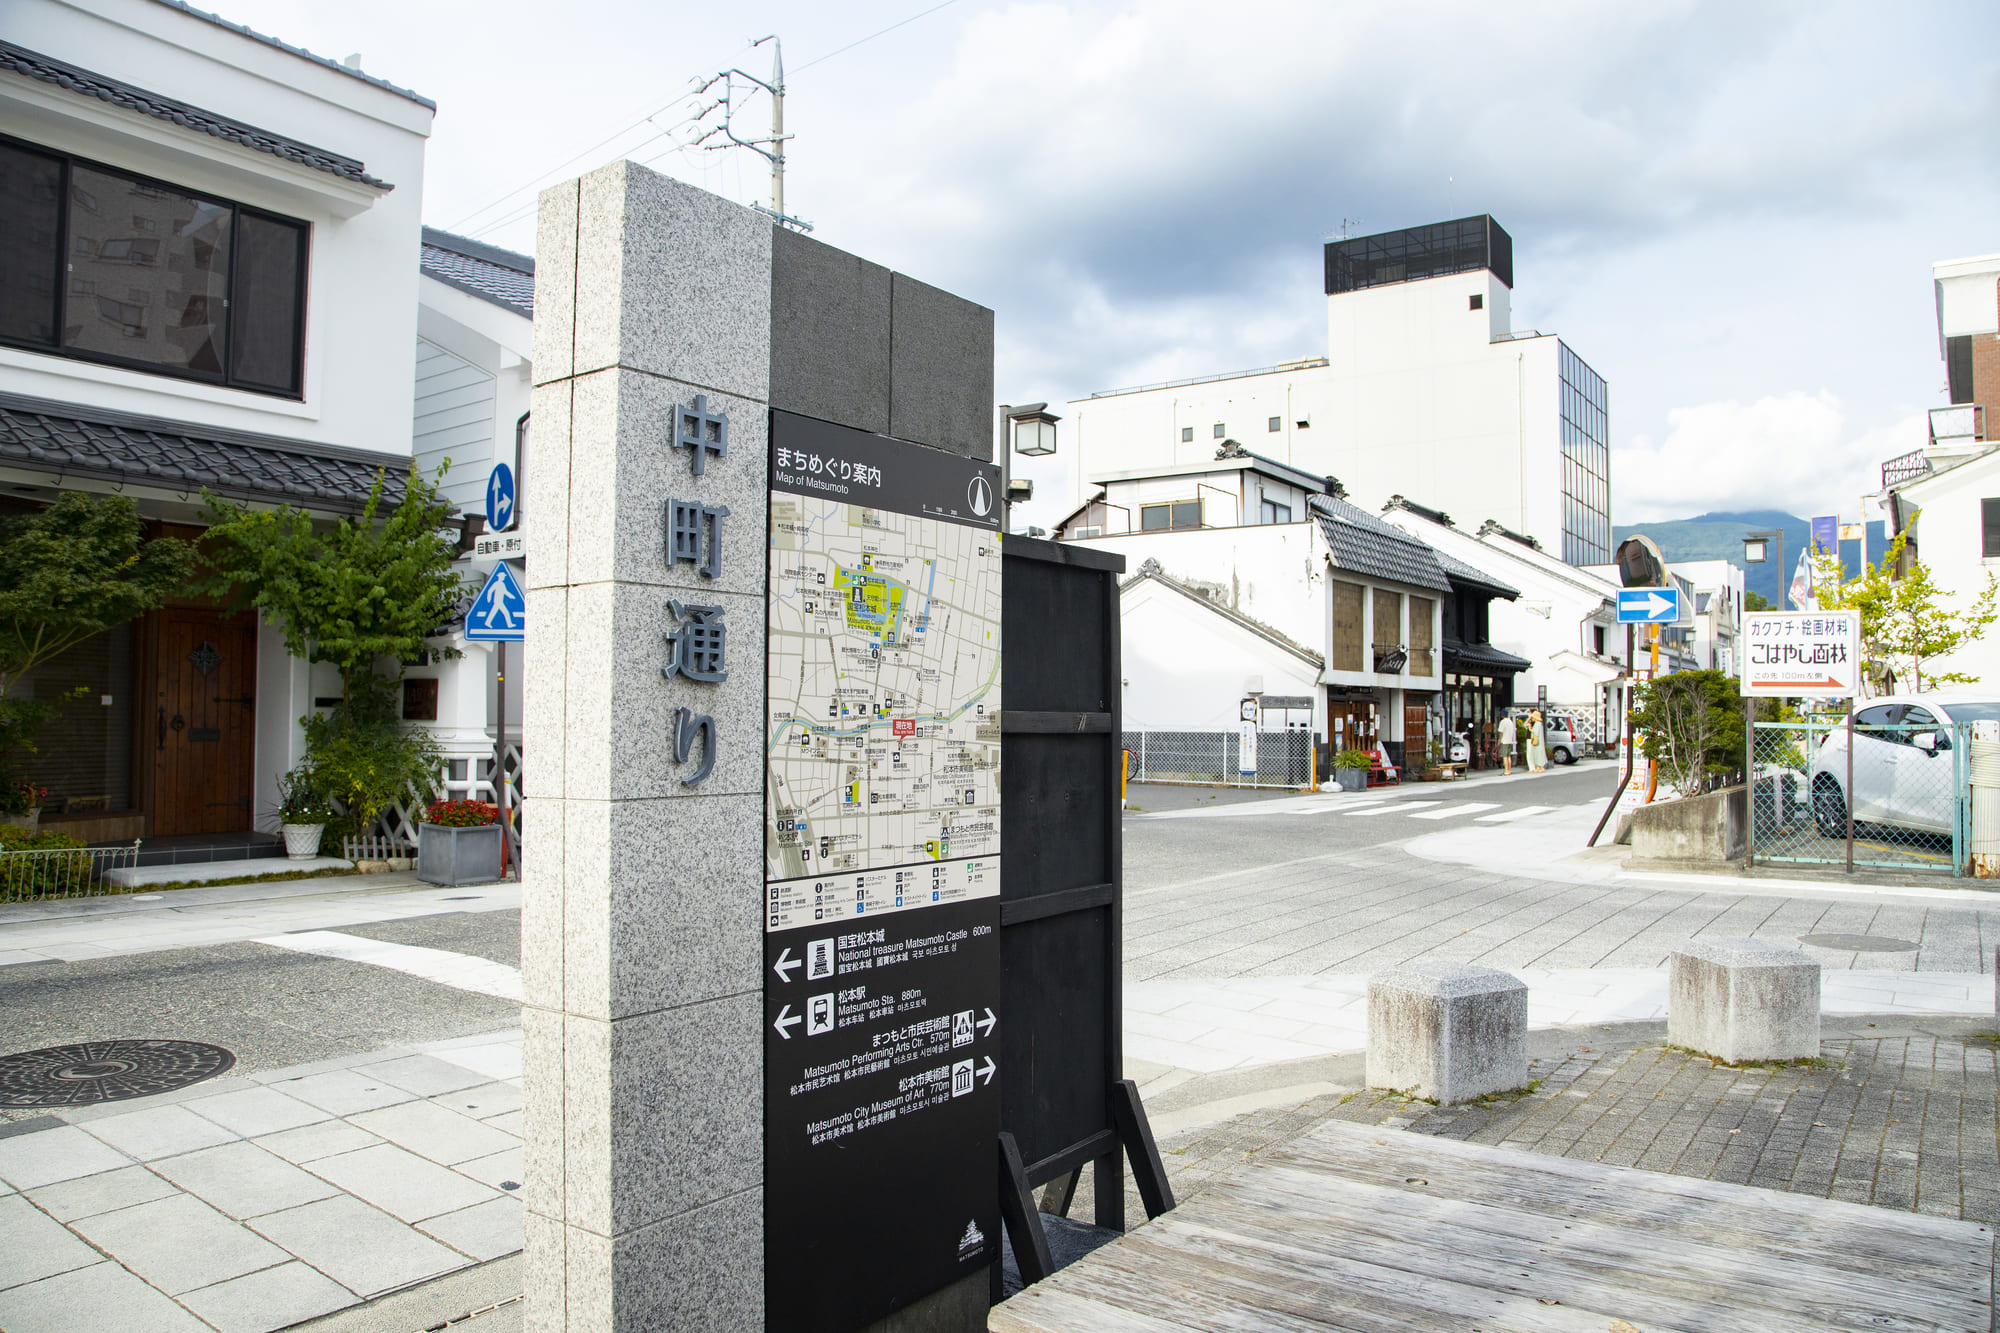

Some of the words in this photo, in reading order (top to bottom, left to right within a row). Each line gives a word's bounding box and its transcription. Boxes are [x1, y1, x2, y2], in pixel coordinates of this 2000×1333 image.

[777, 447, 881, 488] まちめぐり案内
[775, 470, 794, 485] Map
[796, 474, 805, 486] of
[806, 477, 849, 494] Matsumoto
[477, 538, 522, 555] 自動車・原付
[661, 394, 731, 786] 中町通り
[896, 721, 912, 730] 現在地
[838, 928, 885, 950] 国宝松本城
[838, 948, 871, 963] National
[873, 943, 904, 956] treasure
[905, 933, 944, 950] Matsumoto
[946, 929, 968, 943] Castle
[973, 926, 992, 937] 600m
[838, 959, 872, 975] 国宝松本城
[838, 985, 866, 1004] 松本駅
[838, 998, 879, 1016] Matsumoto
[881, 995, 896, 1006] Sta.
[872, 1015, 950, 1048] まつもと市民芸術館
[804, 1059, 850, 1080] Matsumoto
[851, 1045, 894, 1067] Performing
[895, 1040, 910, 1053] Arts
[912, 1037, 925, 1050] Ctr.
[930, 1031, 950, 1044] 570m
[898, 1064, 950, 1093] 松本市美術館
[806, 1113, 852, 1135] Matsumoto
[854, 1106, 870, 1120] City
[871, 1094, 904, 1114] Museum
[905, 1091, 913, 1103] of
[913, 1087, 925, 1099] Art
[930, 1080, 950, 1094] 770m
[811, 1124, 854, 1146] 松本市美术馆
